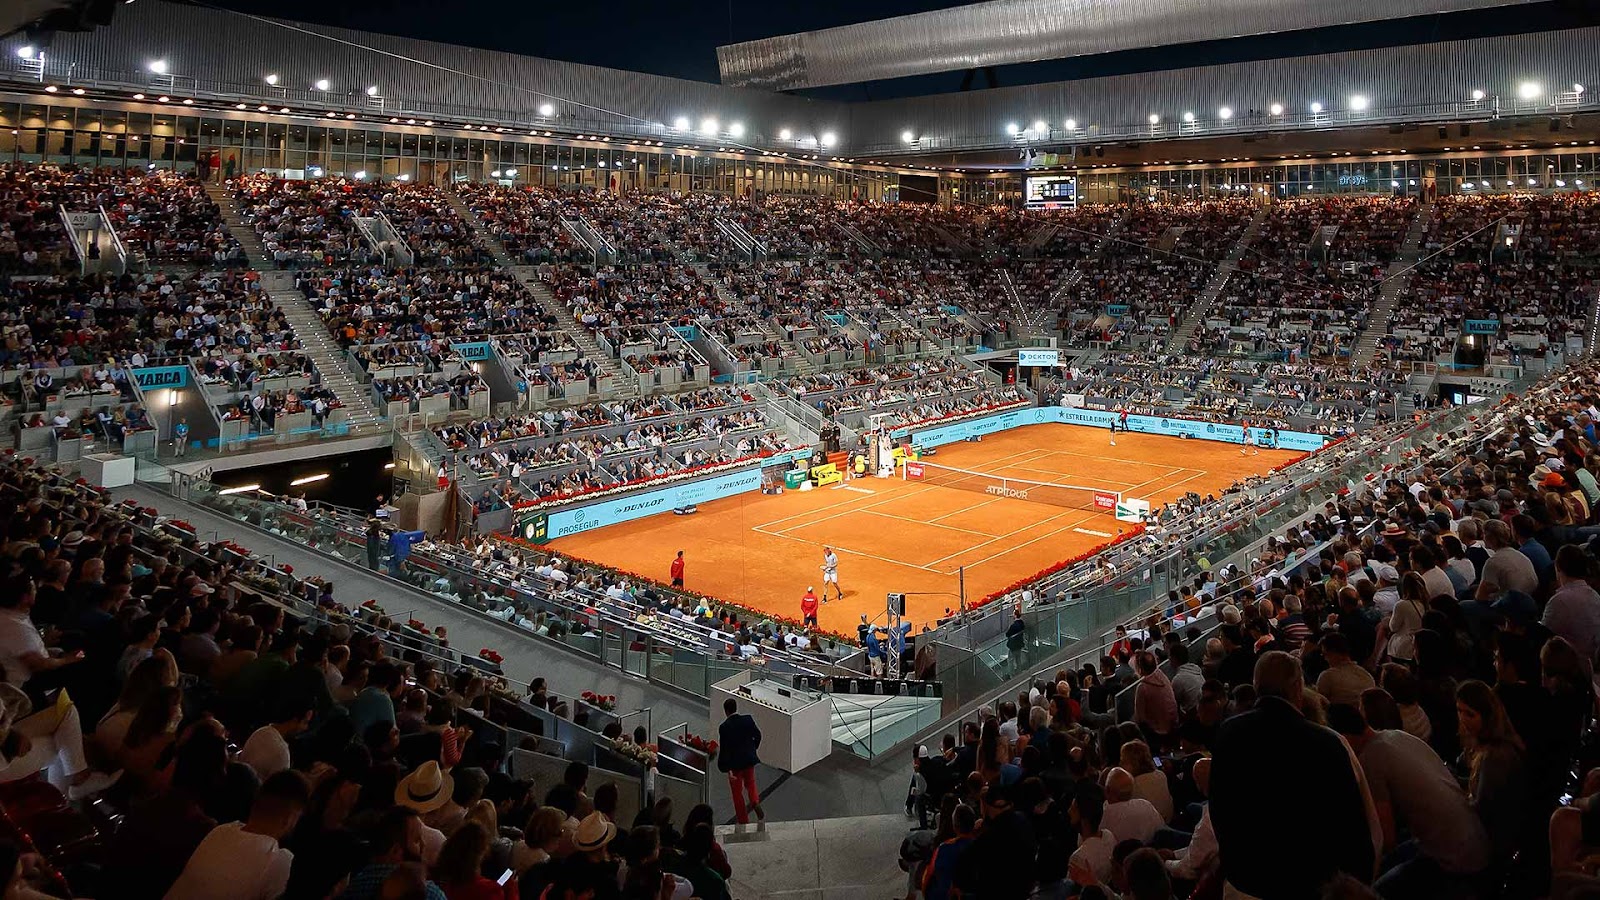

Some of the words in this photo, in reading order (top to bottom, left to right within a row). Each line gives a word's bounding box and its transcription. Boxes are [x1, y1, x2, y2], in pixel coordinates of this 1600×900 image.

[1065, 413, 1093, 423] ESTRELLA
[1278, 436, 1322, 446] adrid-open.com
[723, 476, 758, 490] DUNLOP
[623, 498, 665, 513] DUNLOP
[558, 519, 599, 536] PROSEGUR
